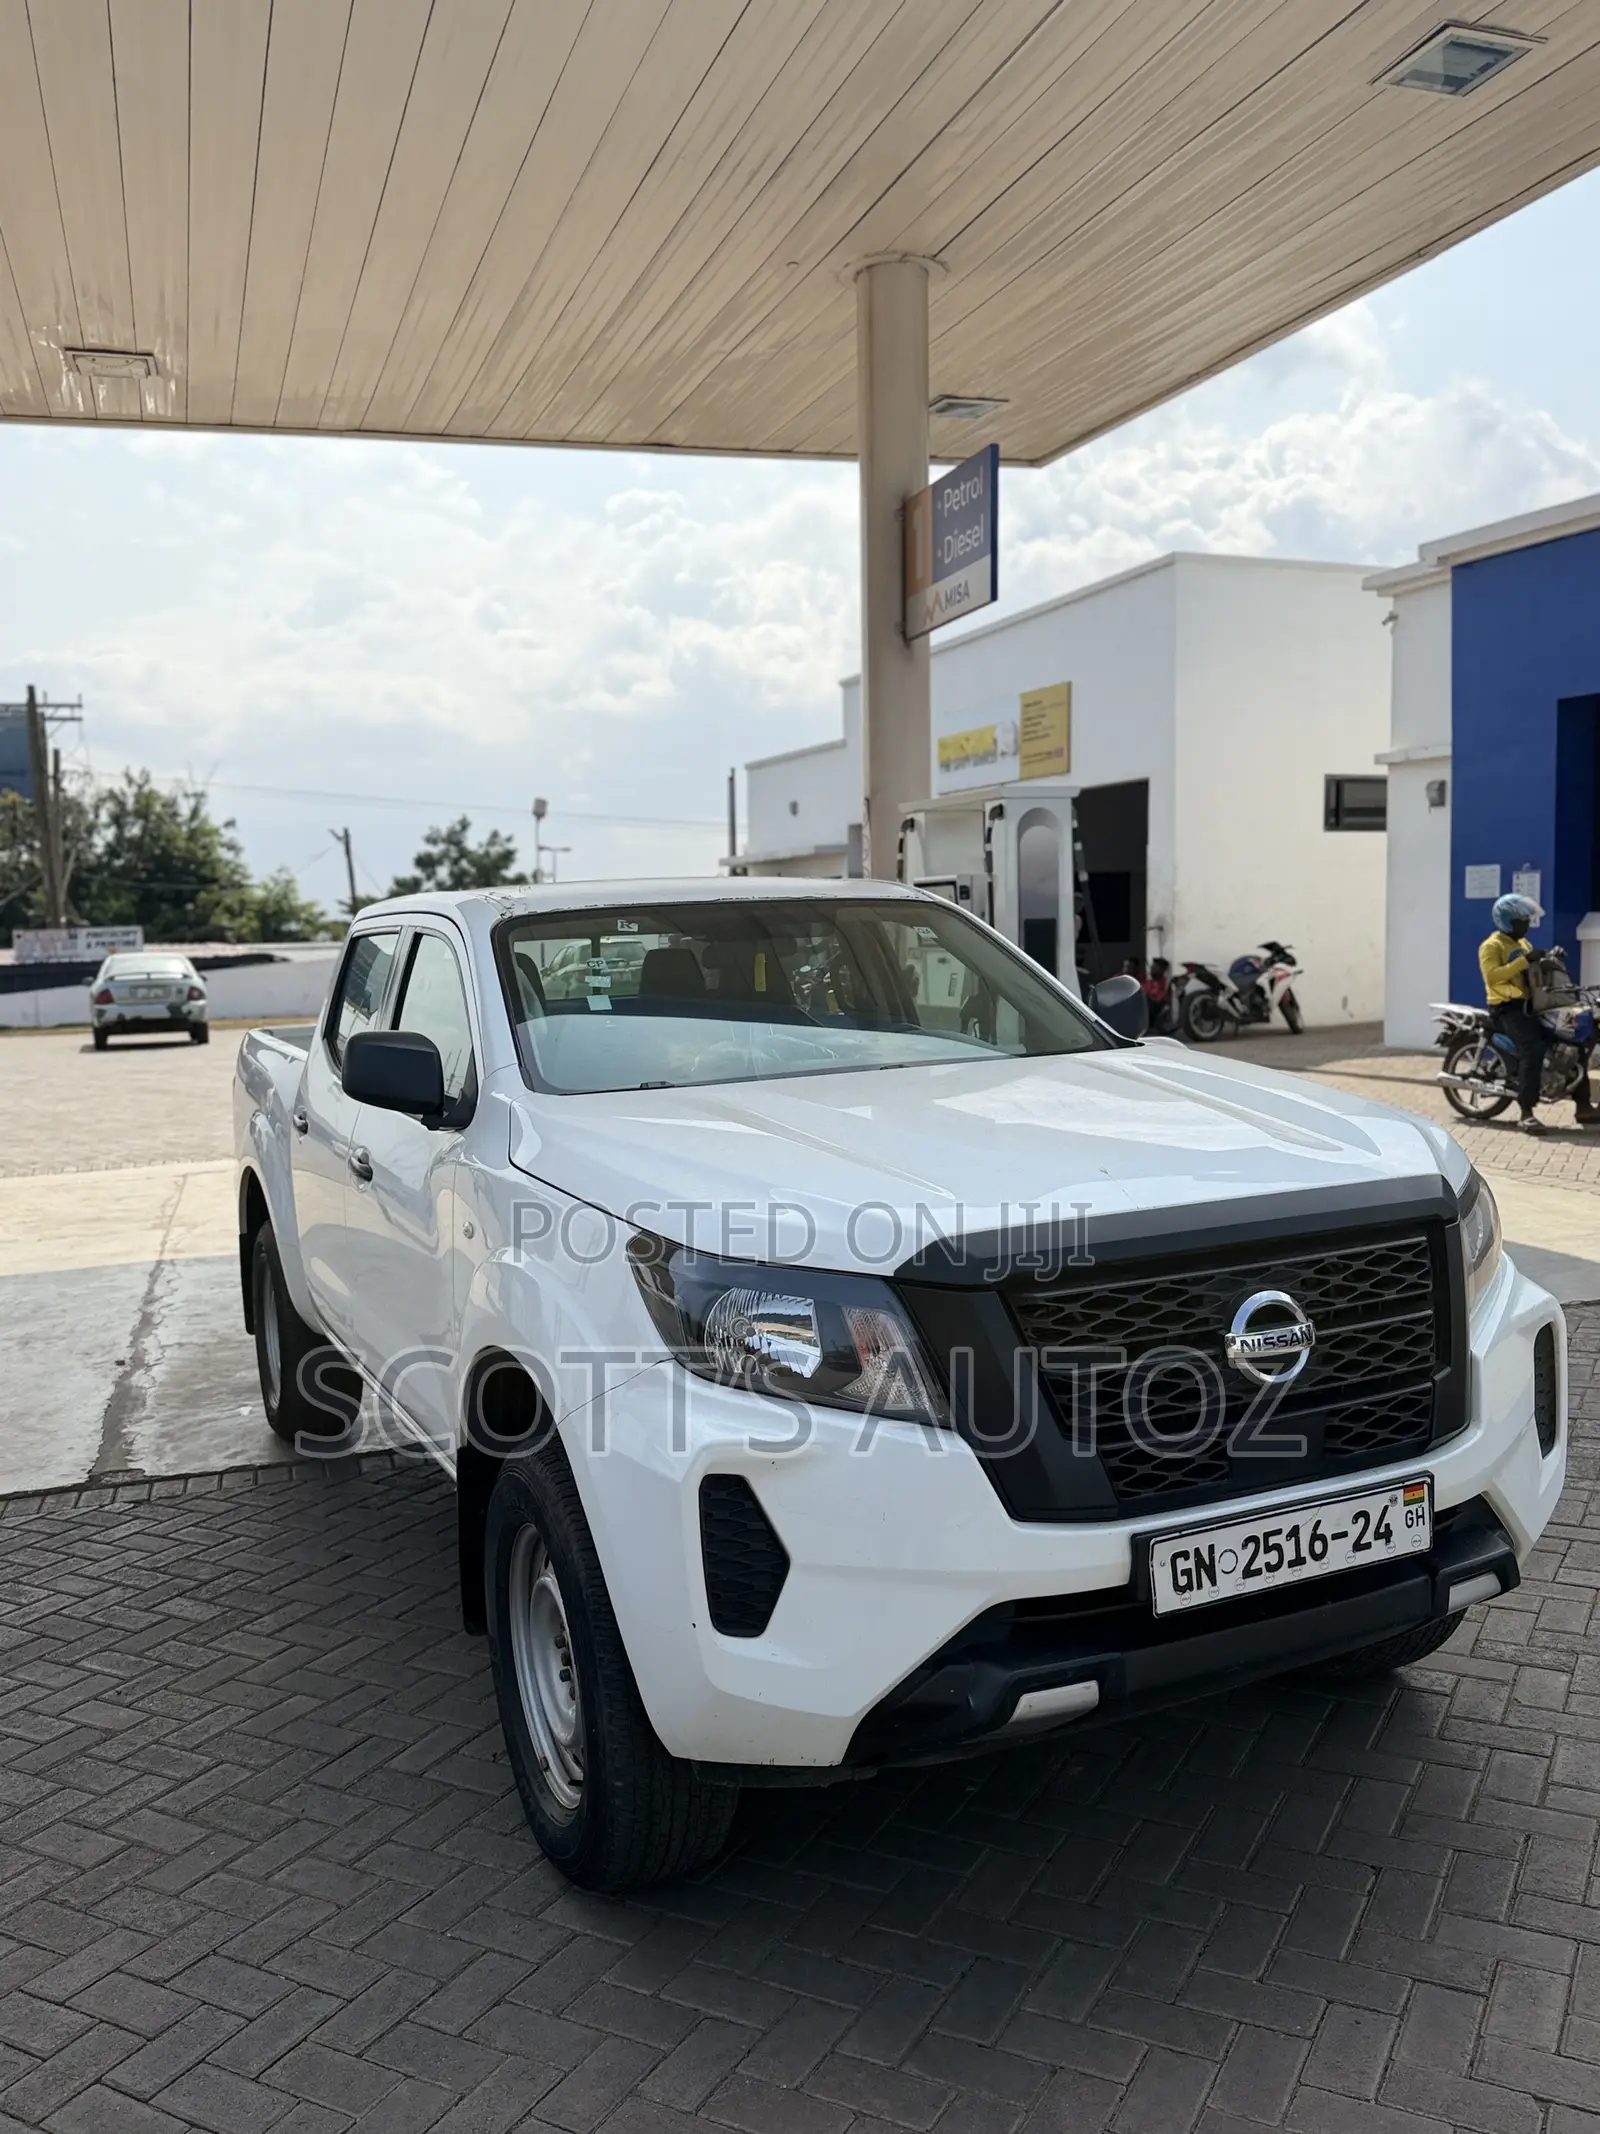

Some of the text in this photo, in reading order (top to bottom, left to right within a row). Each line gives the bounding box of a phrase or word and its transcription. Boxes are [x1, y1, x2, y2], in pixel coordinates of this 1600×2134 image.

[943, 465, 984, 518] Petrol
[943, 513, 984, 565] Diesel
[1239, 1324, 1315, 1354] NISSAN
[1404, 1507, 1426, 1529] GH
[1169, 1504, 1394, 1595] GN 2516-24
